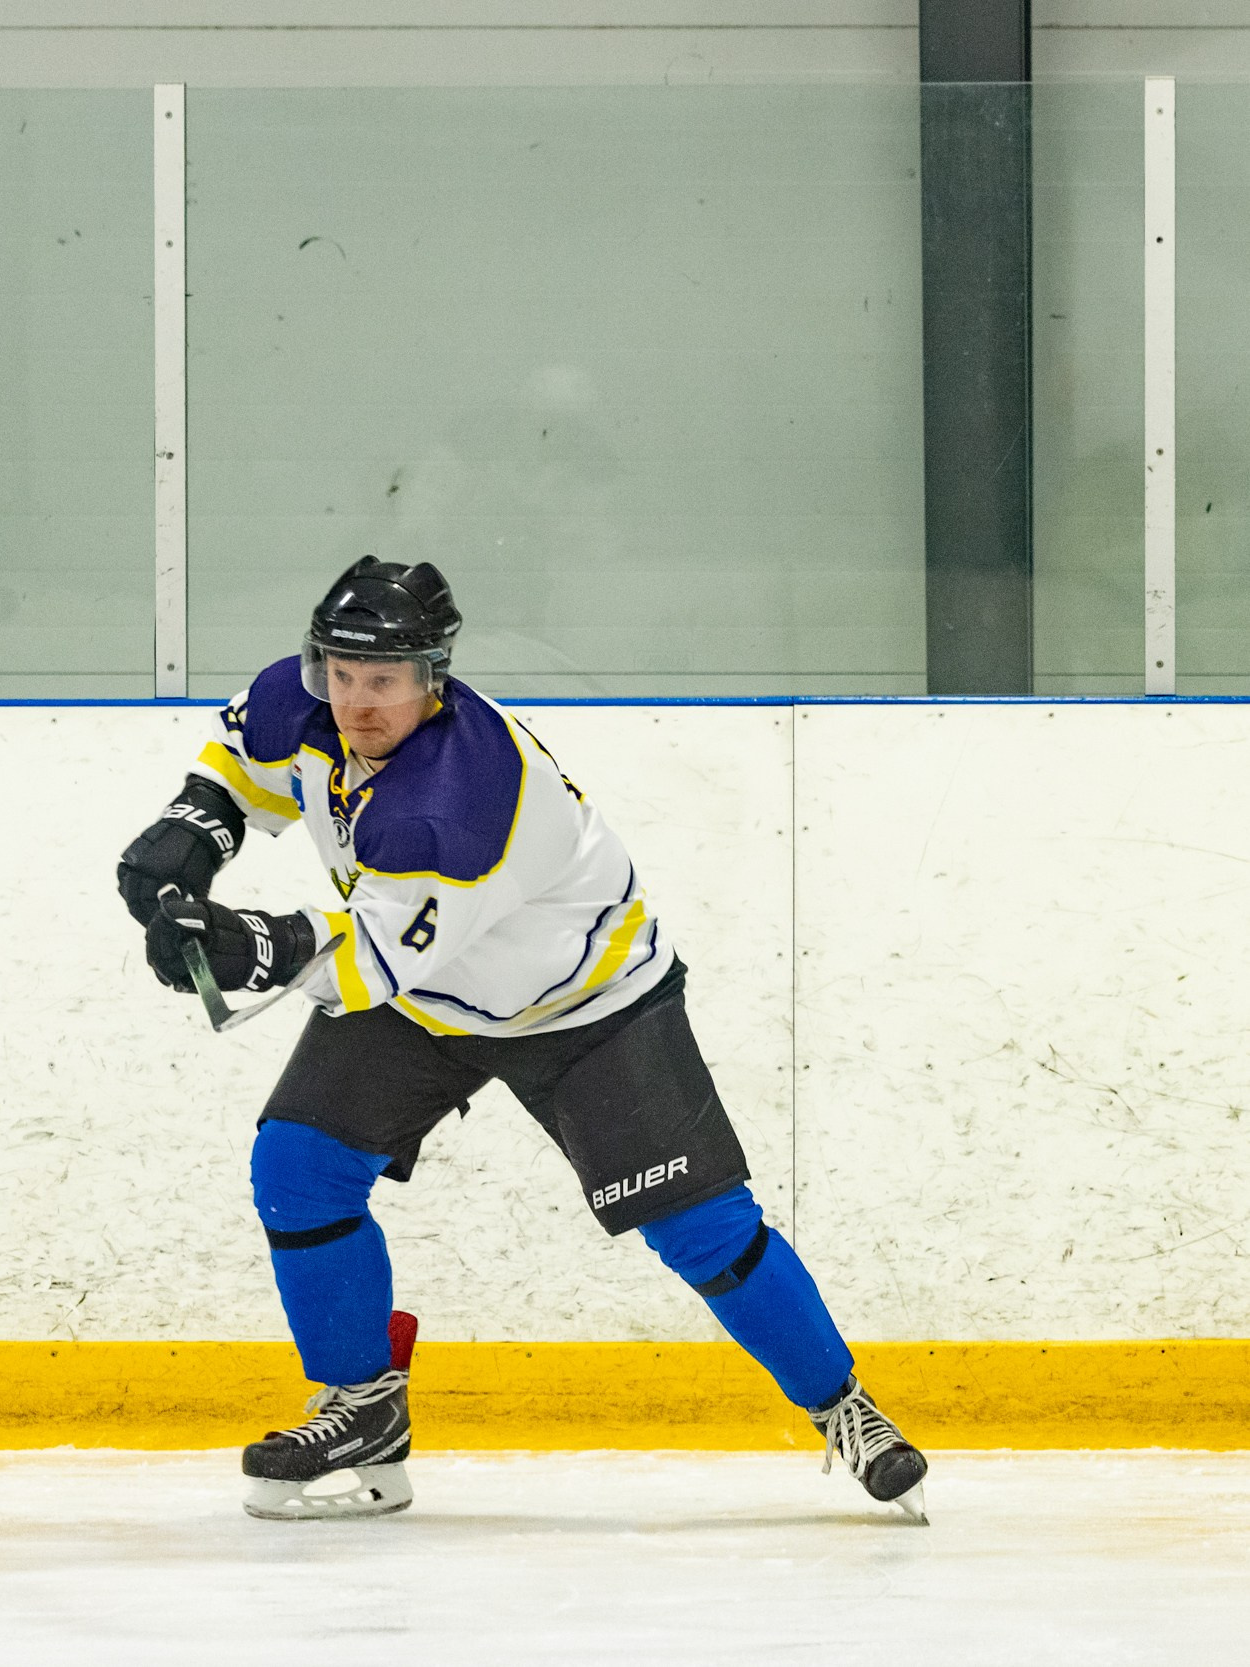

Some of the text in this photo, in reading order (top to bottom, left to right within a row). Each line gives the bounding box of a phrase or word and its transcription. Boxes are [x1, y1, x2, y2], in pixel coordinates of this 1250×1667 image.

[236, 912, 274, 992] BAU
[400, 895, 438, 954] 6
[592, 1155, 689, 1210] BAUER
